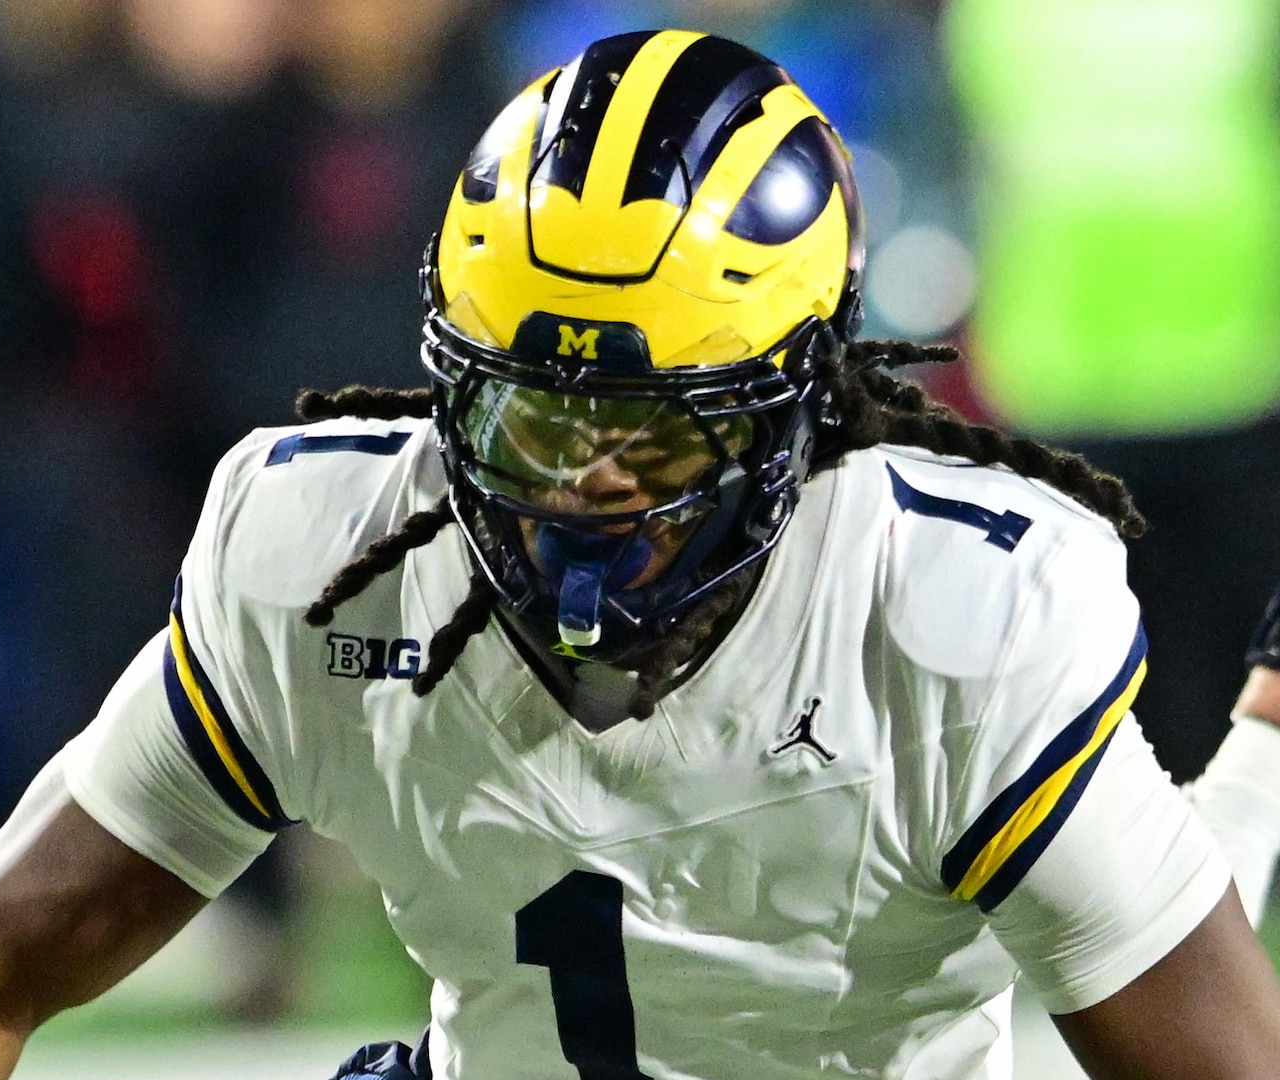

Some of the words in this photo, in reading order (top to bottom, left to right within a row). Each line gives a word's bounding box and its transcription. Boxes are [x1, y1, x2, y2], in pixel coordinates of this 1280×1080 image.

[556, 324, 601, 360] M
[264, 432, 413, 467] 1
[885, 459, 1034, 554] 1
